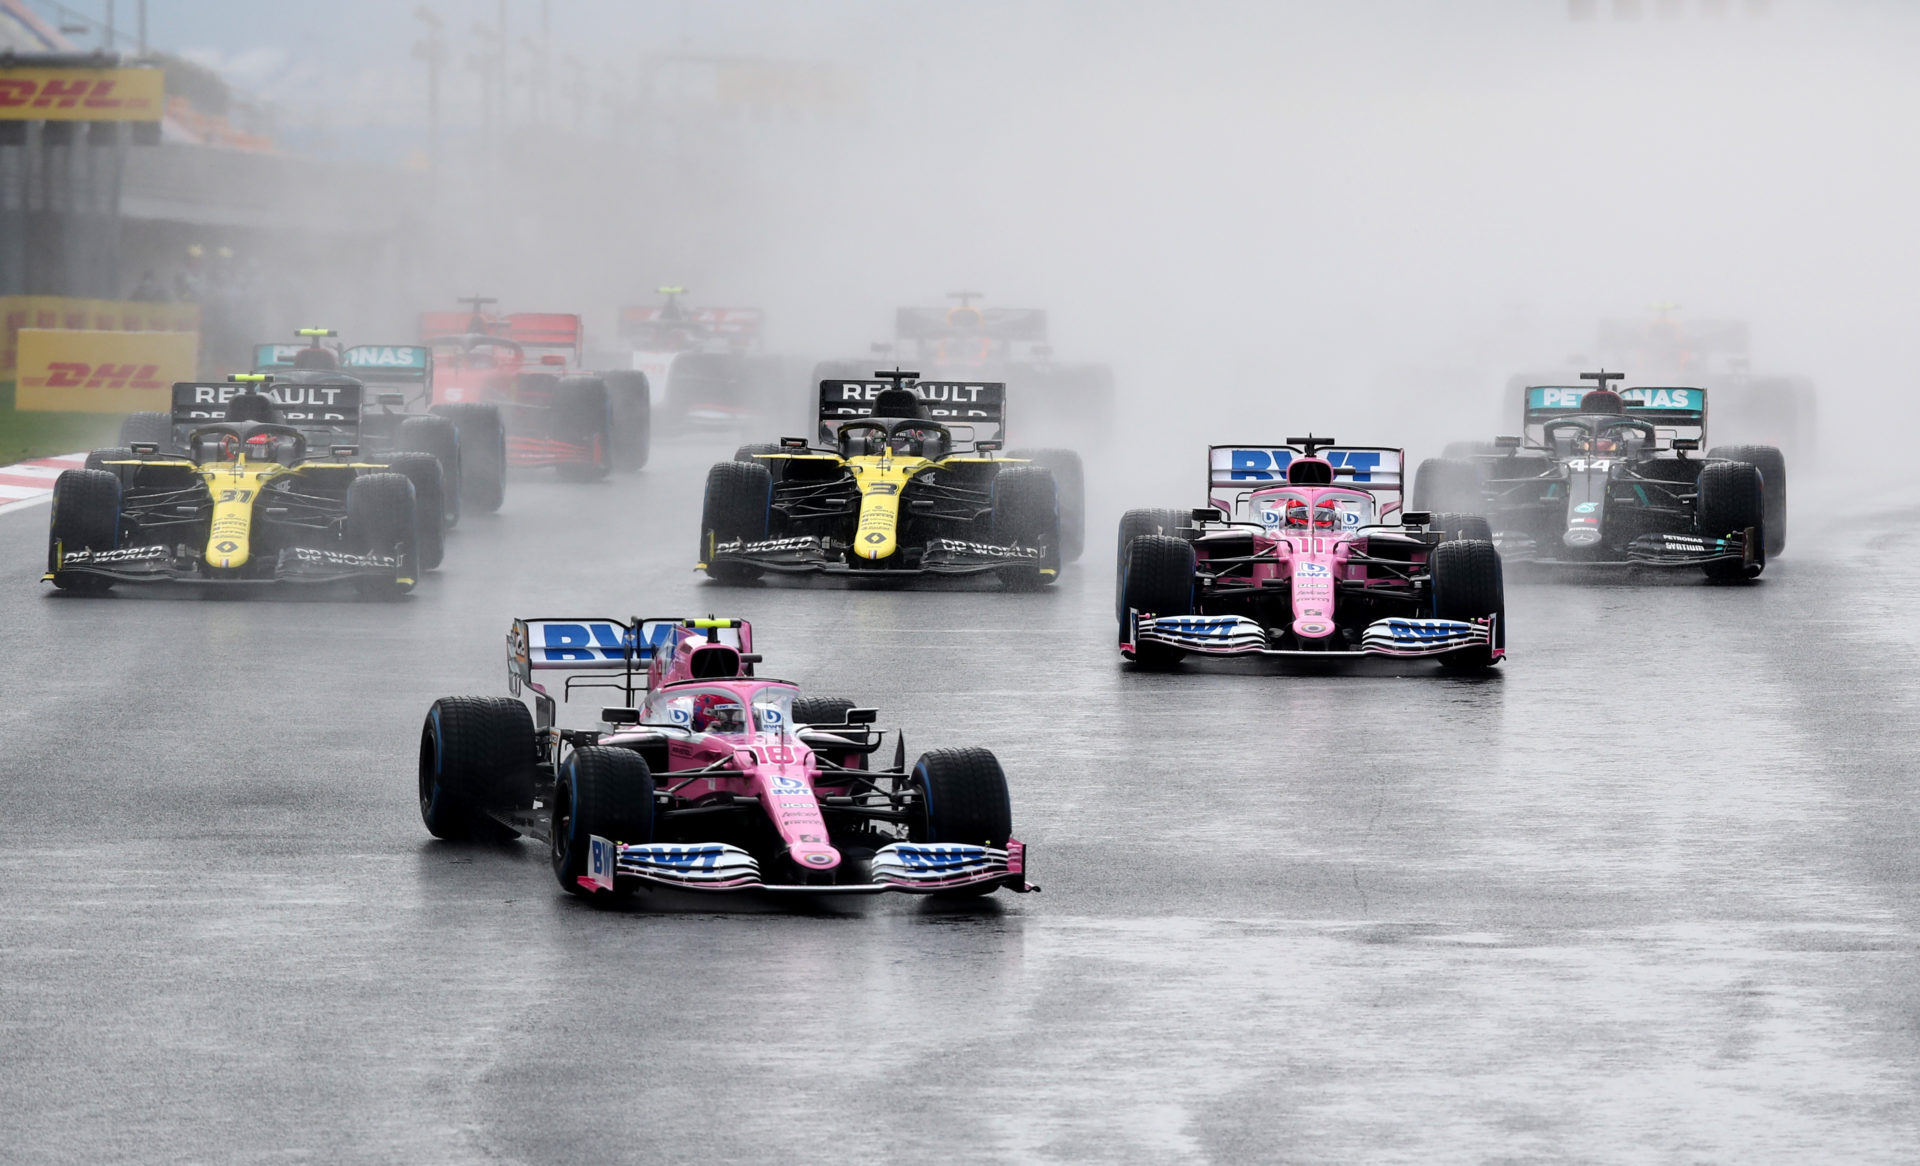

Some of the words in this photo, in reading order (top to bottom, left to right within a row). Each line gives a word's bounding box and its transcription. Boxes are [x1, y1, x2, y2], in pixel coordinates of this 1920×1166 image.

[0, 79, 120, 108] DHL
[46, 362, 164, 388] DHL
[842, 384, 984, 402] REAULT
[1568, 460, 1610, 471] 44
[745, 536, 813, 553] WORLD
[969, 543, 1038, 559] WORLD
[1299, 537, 1325, 553] 11
[92, 545, 163, 564] WORLD
[752, 745, 796, 765] 18
